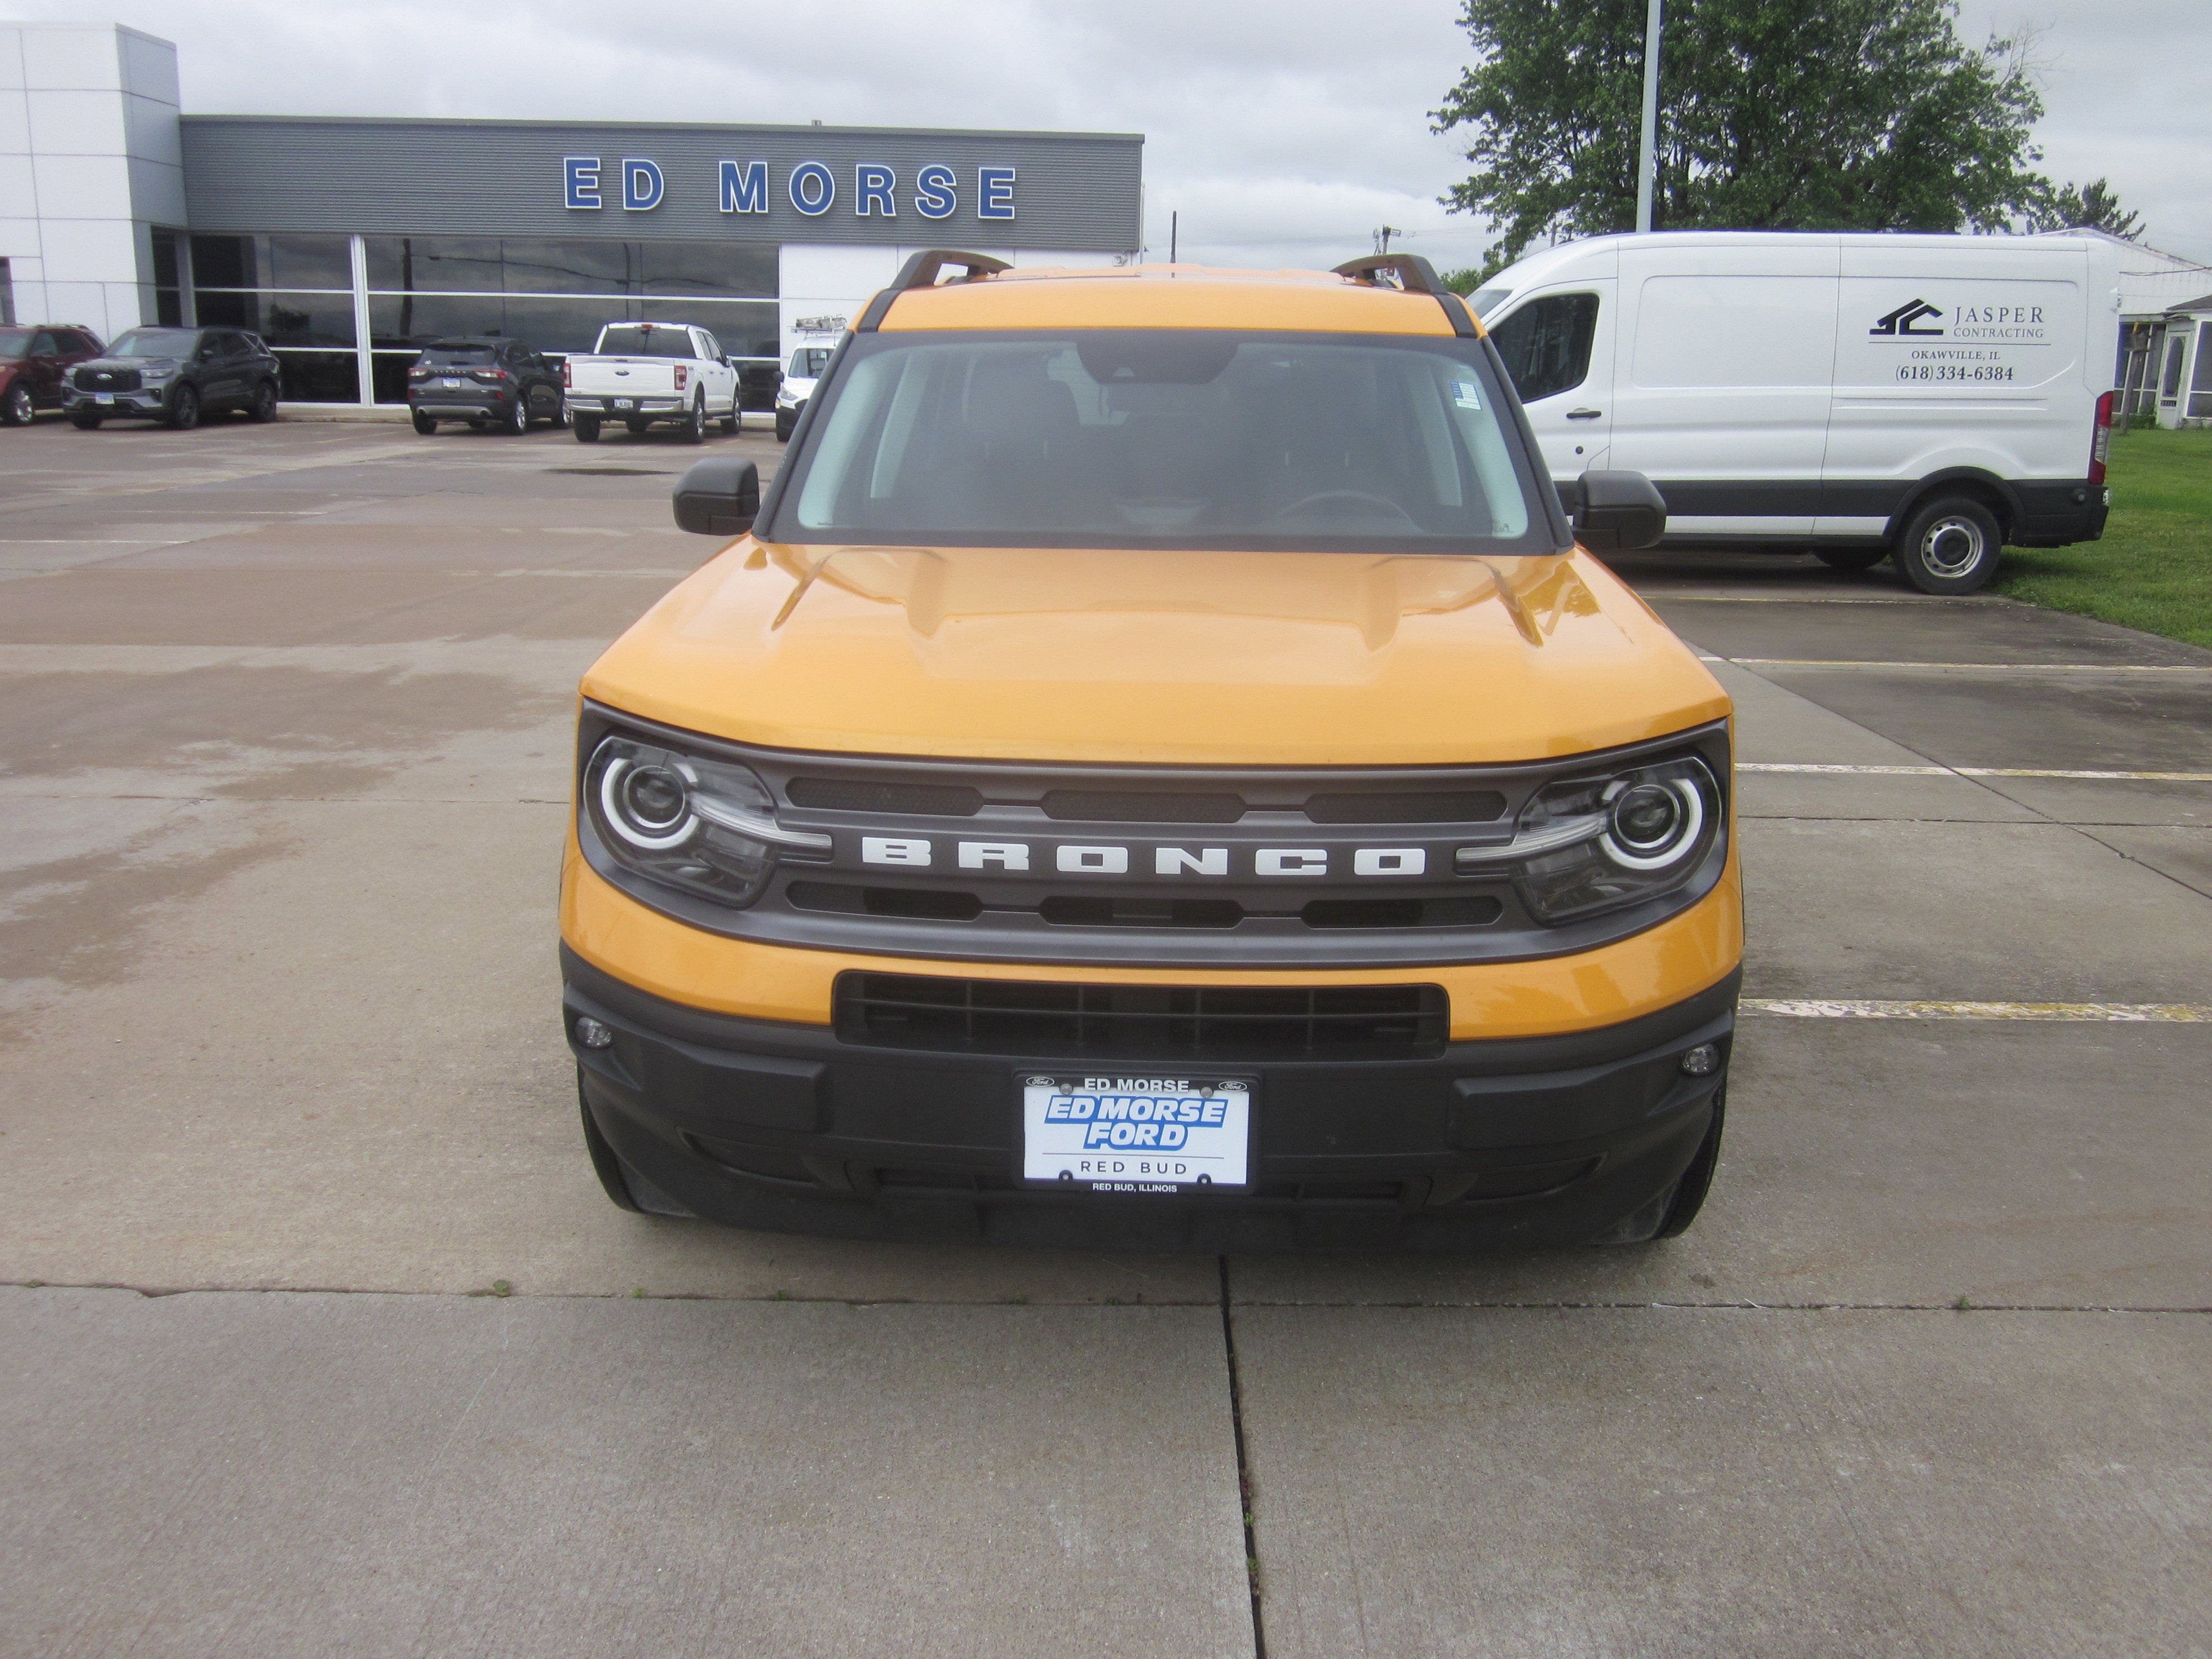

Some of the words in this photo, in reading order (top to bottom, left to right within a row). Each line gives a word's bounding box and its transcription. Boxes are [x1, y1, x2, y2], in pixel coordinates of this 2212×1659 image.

[563, 156, 665, 211] ED
[718, 160, 1016, 220] MORSE
[1954, 306, 2044, 326] JASPER
[1953, 327, 2044, 338] CONTRACTING
[1911, 350, 1985, 361] OKAWVILLE,
[1989, 351, 2001, 360] IL
[862, 836, 1426, 876] BRONCO
[1084, 1078, 1110, 1092] ED
[1117, 1079, 1190, 1093] MORSE
[1087, 1122, 1187, 1146] FORD
[1081, 1161, 1125, 1173] RED
[1140, 1162, 1187, 1175] BUD
[1092, 1182, 1112, 1191] RED
[1114, 1183, 1137, 1193] BUD,
[1138, 1184, 1178, 1193] ILLINOIS
